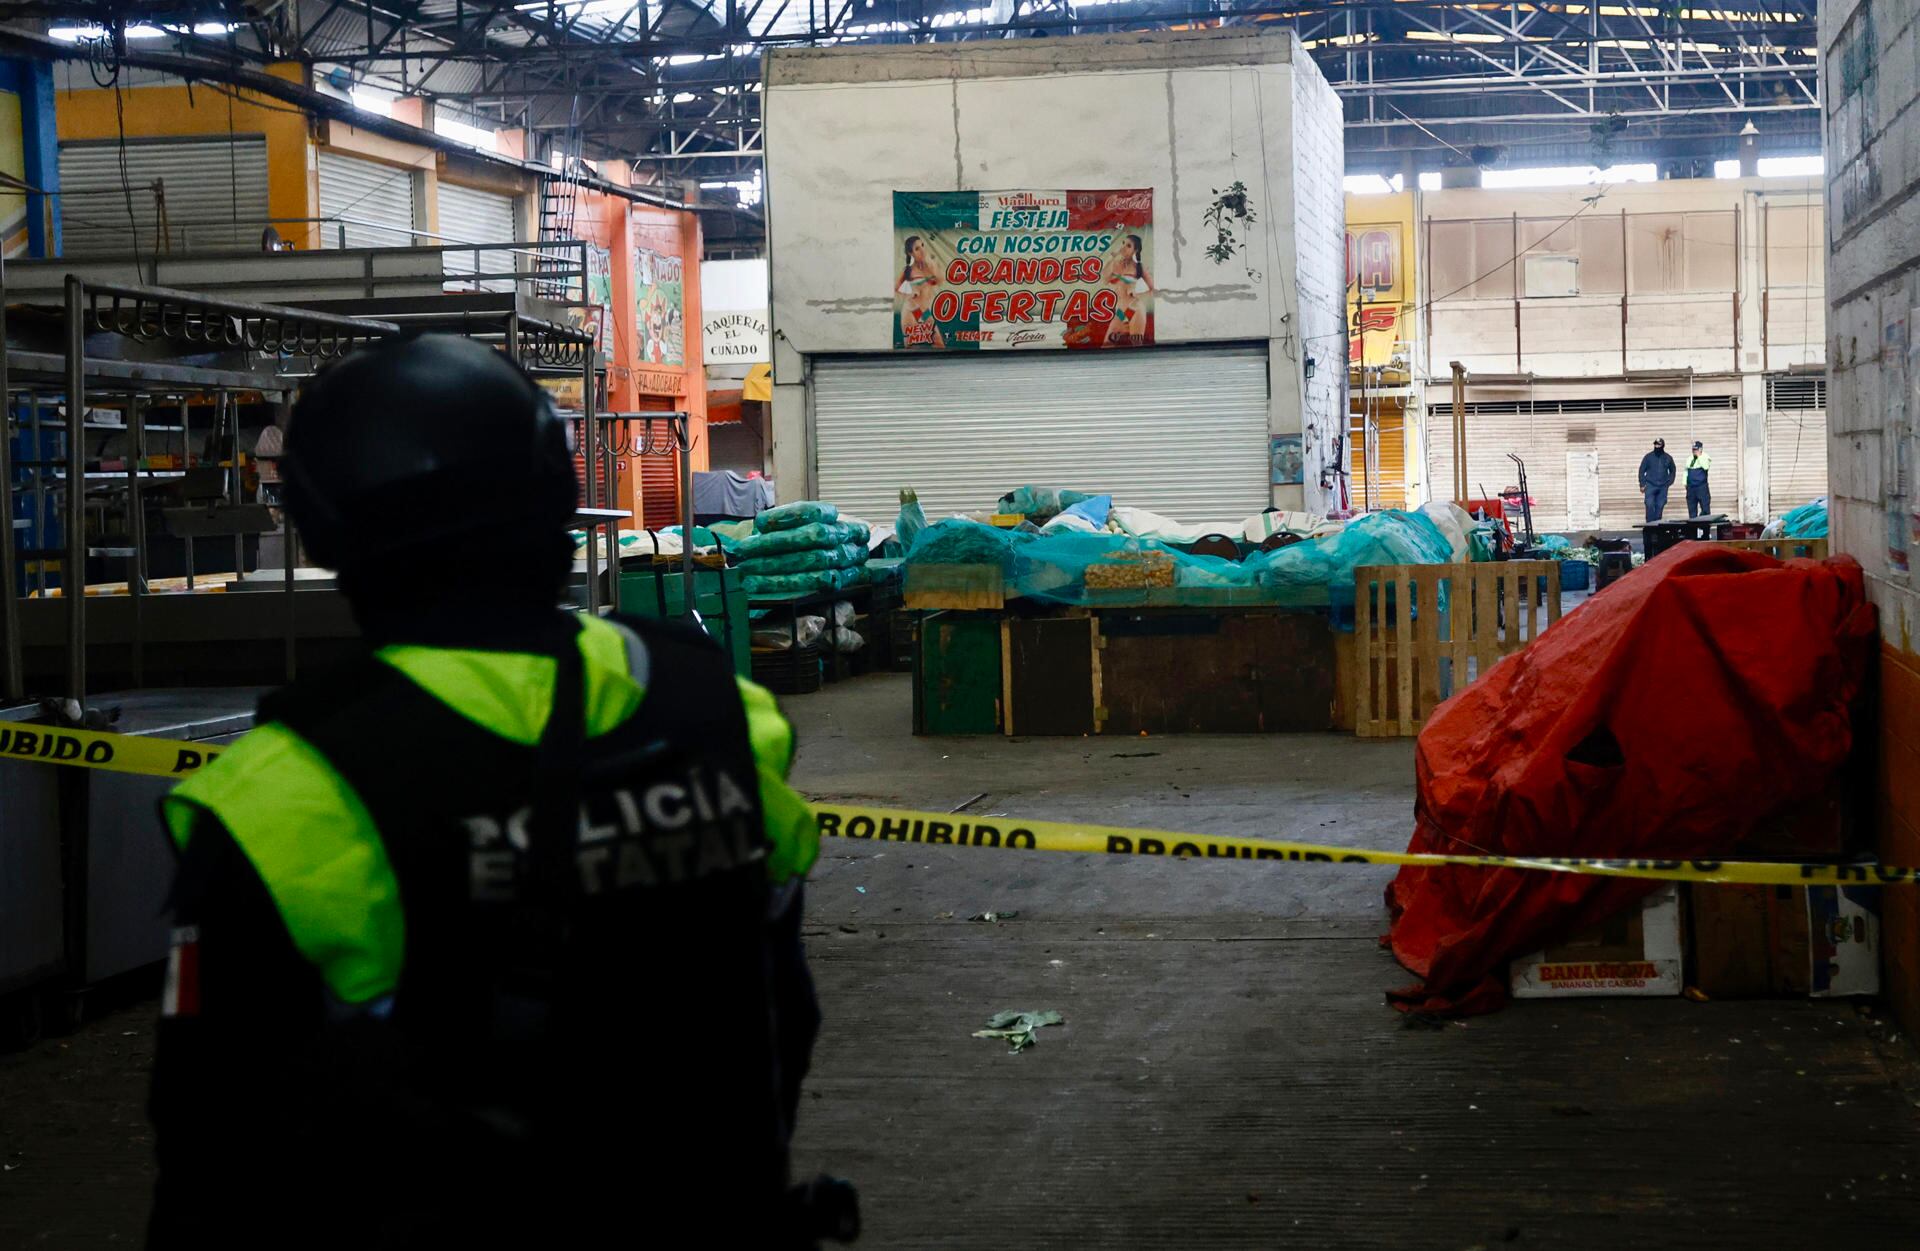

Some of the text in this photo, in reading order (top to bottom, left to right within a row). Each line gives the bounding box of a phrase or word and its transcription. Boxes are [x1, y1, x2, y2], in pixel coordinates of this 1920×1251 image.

[991, 210, 1070, 229] FESTEJA
[956, 235, 1112, 254] CON NOSOTROS
[946, 257, 1103, 285] GRANDES
[931, 290, 1118, 323] OFERTAS
[703, 315, 768, 336] TAQUERIA
[724, 329, 741, 339] EL
[905, 322, 932, 334] NEW
[907, 332, 933, 344] MIX
[467, 818, 769, 903] ETATAL
[1594, 980, 1607, 988] DE
